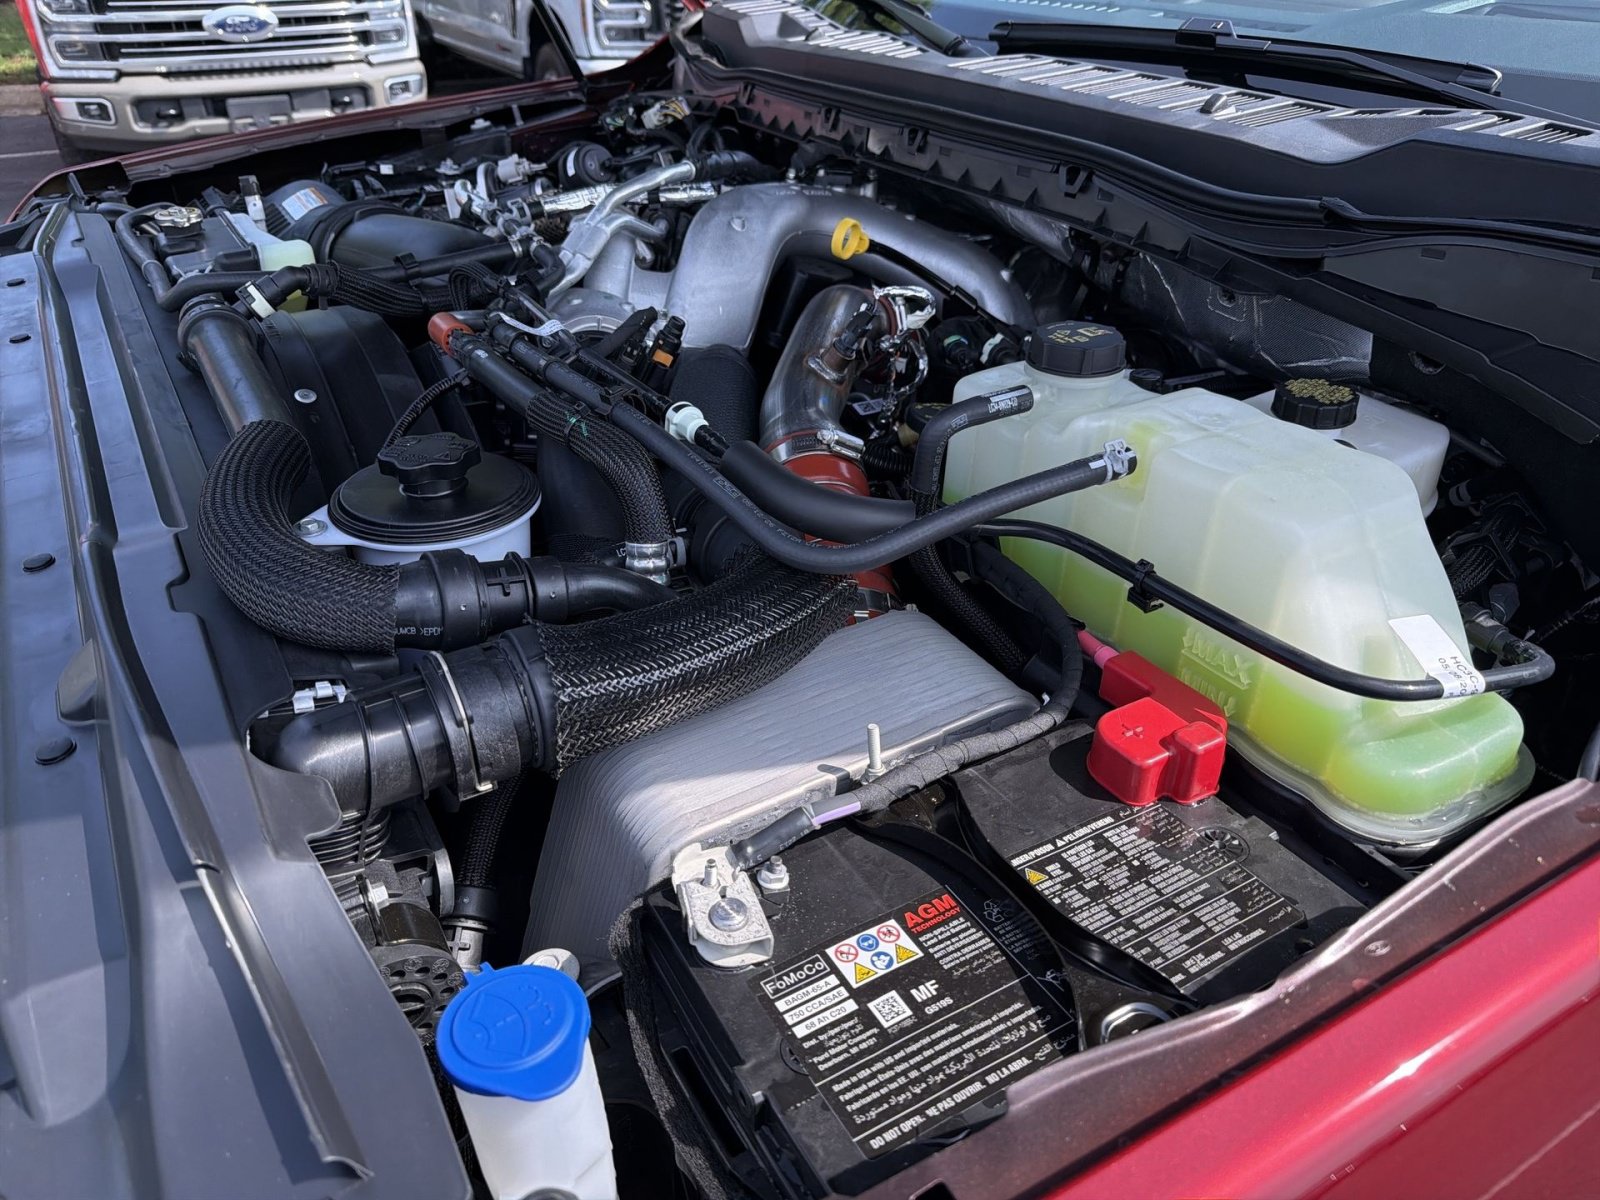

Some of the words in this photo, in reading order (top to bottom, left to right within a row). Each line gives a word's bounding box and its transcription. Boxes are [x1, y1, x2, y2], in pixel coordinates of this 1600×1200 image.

[904, 893, 958, 928] AGM
[912, 907, 962, 933] TECHNOLOGY
[919, 917, 965, 941] NON-SPILLABLE
[937, 931, 951, 940] Acid
[950, 921, 972, 934] Battery
[765, 960, 825, 994] FoMoCo
[784, 980, 831, 1006] BAGM-65-A
[909, 979, 943, 1003] MF
[789, 1010, 805, 1021] 750
[804, 990, 845, 1013] CCA/SAE
[805, 1022, 816, 1030] 68
[816, 1015, 829, 1024] Ah
[829, 1006, 847, 1018] C20
[924, 996, 954, 1015] G519S
[813, 1052, 829, 1063] Ford
[829, 1042, 849, 1055] Motor
[859, 1037, 877, 1049] 48121
[832, 1079, 851, 1092] Made
[856, 1068, 872, 1079] USA
[870, 1061, 885, 1072] with
[883, 1056, 894, 1065] US
[893, 1050, 906, 1060] and
[904, 1037, 932, 1054] imported
[869, 1136, 885, 1149] DO
[882, 1126, 903, 1142] NOT
[899, 1113, 927, 1133] OPEN.
[937, 1097, 956, 1112] PAS
[952, 1080, 987, 1103] OUVRIR.
[985, 1073, 1001, 1085] NO
[997, 1067, 1011, 1078] LA
[1006, 1055, 1033, 1073] ABRA.
